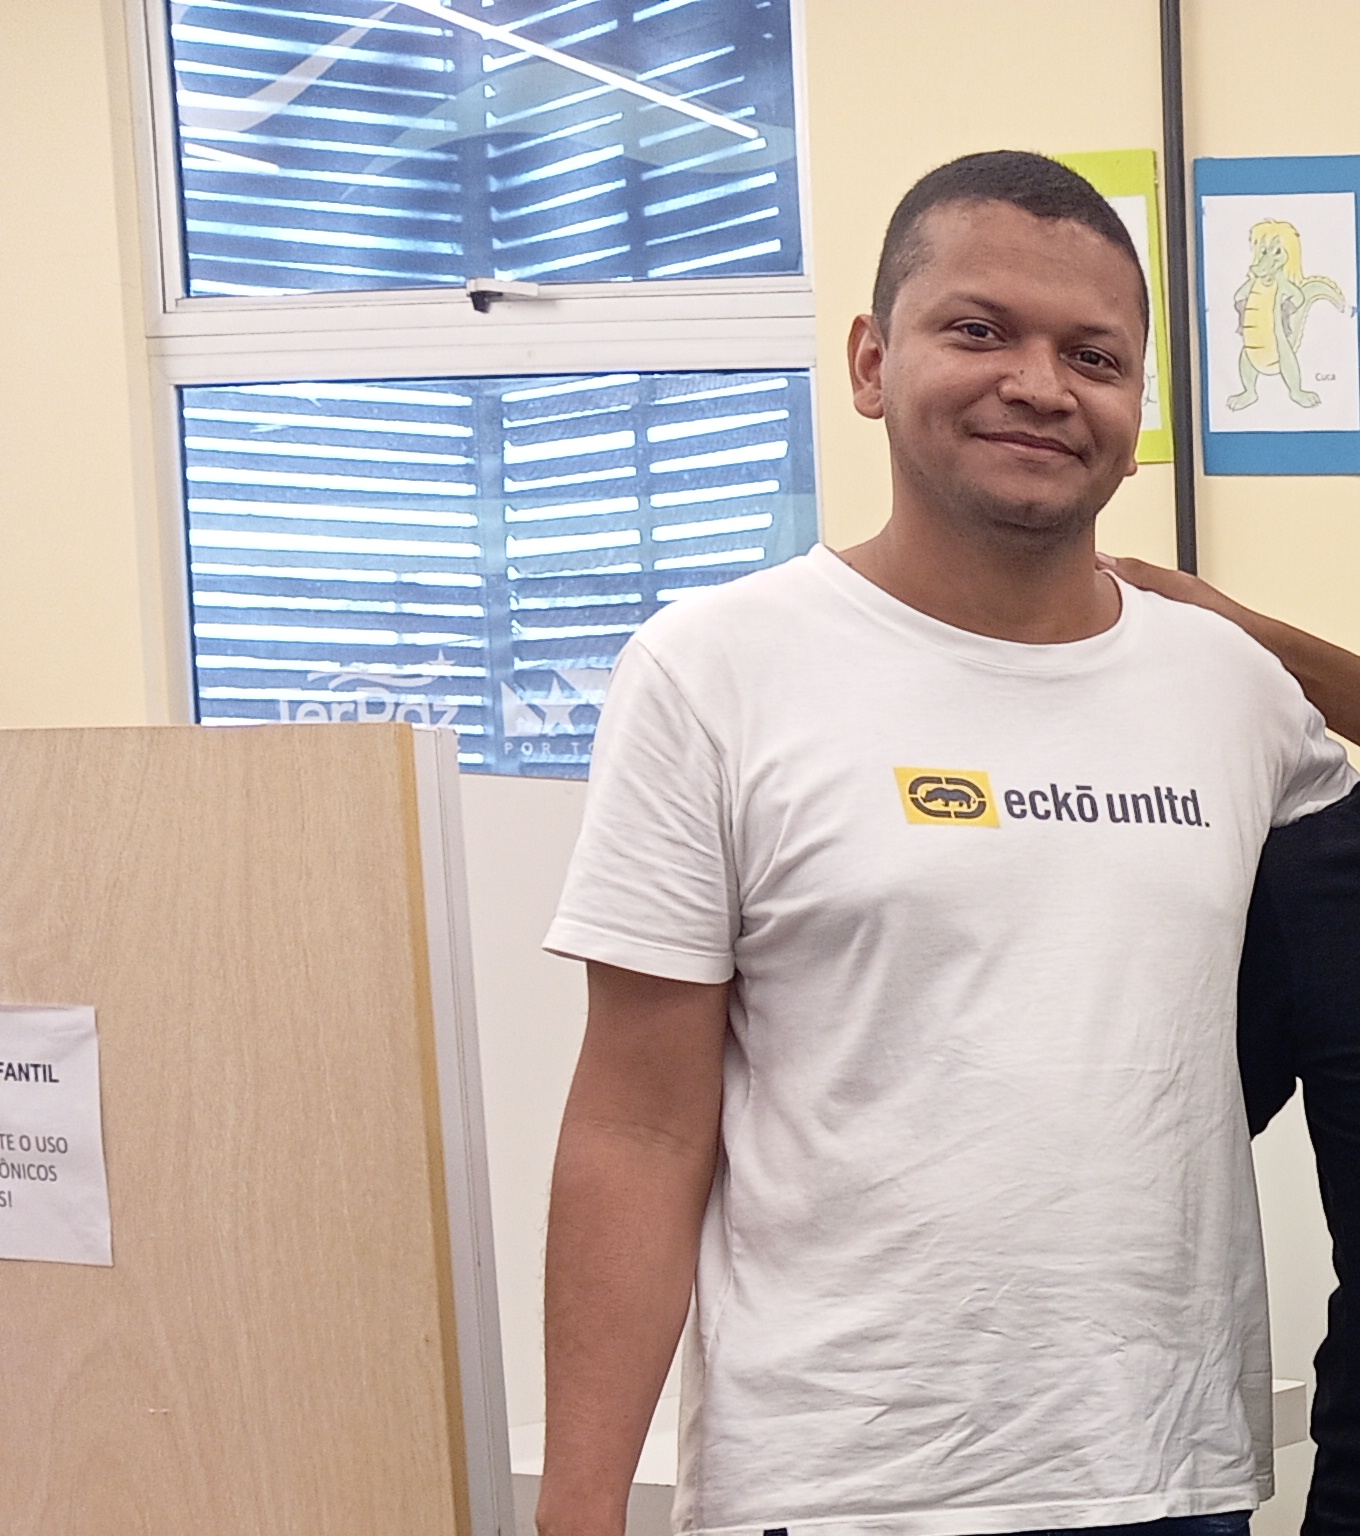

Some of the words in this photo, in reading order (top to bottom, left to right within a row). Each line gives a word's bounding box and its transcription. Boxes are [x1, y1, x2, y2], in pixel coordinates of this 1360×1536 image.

[1314, 371, 1337, 383] Cuca
[1105, 785, 1212, 828] unltd.
[18, 1134, 32, 1152] O
[34, 1135, 69, 1154] USO
